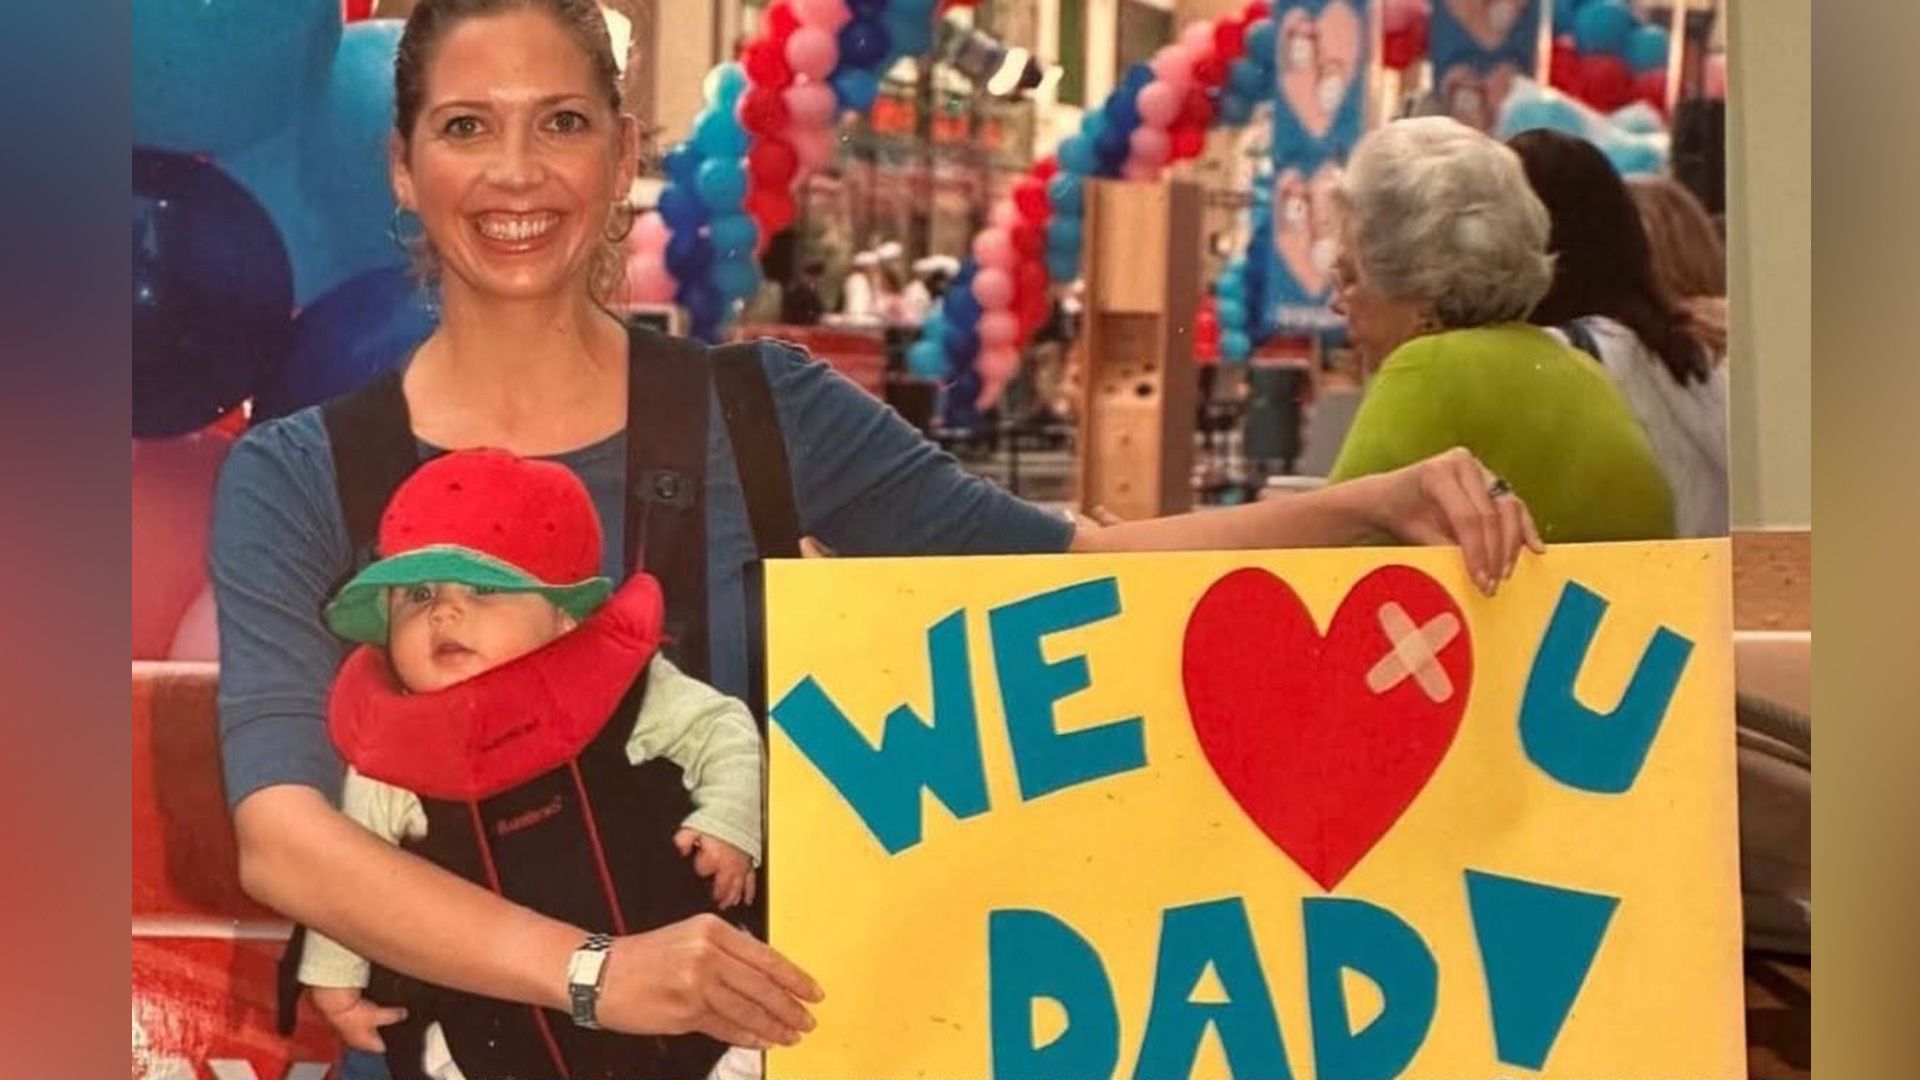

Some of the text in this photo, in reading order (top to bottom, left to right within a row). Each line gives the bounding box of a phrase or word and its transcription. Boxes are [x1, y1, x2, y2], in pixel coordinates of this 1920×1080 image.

[769, 576, 1695, 856] WE U
[988, 869, 1621, 1080] DAD!
